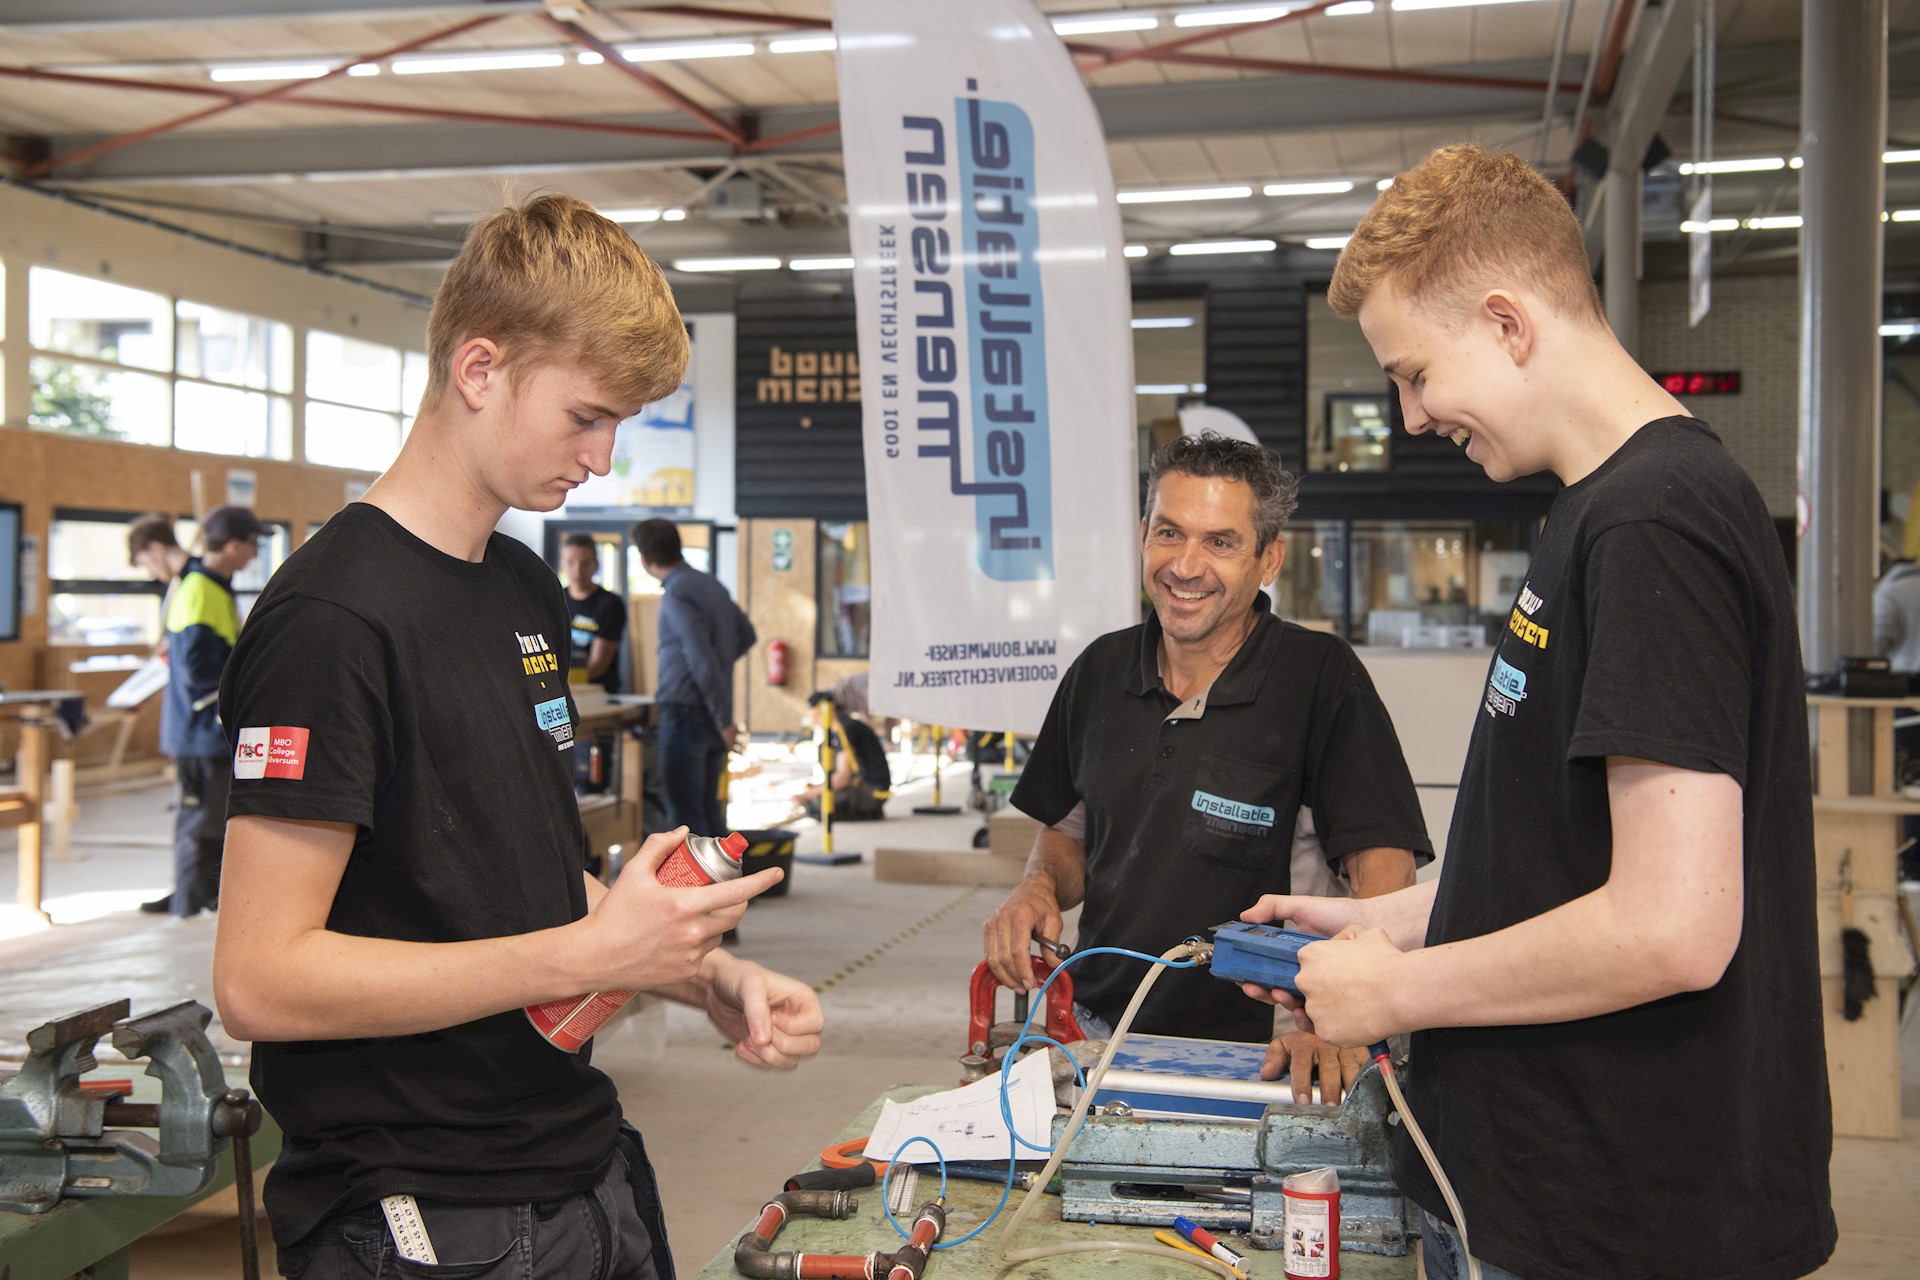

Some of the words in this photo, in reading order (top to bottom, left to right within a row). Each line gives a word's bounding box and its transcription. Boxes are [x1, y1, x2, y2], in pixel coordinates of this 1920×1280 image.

[757, 377, 861, 403] mens
[270, 748, 295, 756] College
[389, 1201, 396, 1212] 52
[402, 1236, 409, 1246] 55
[406, 1247, 413, 1258] 56
